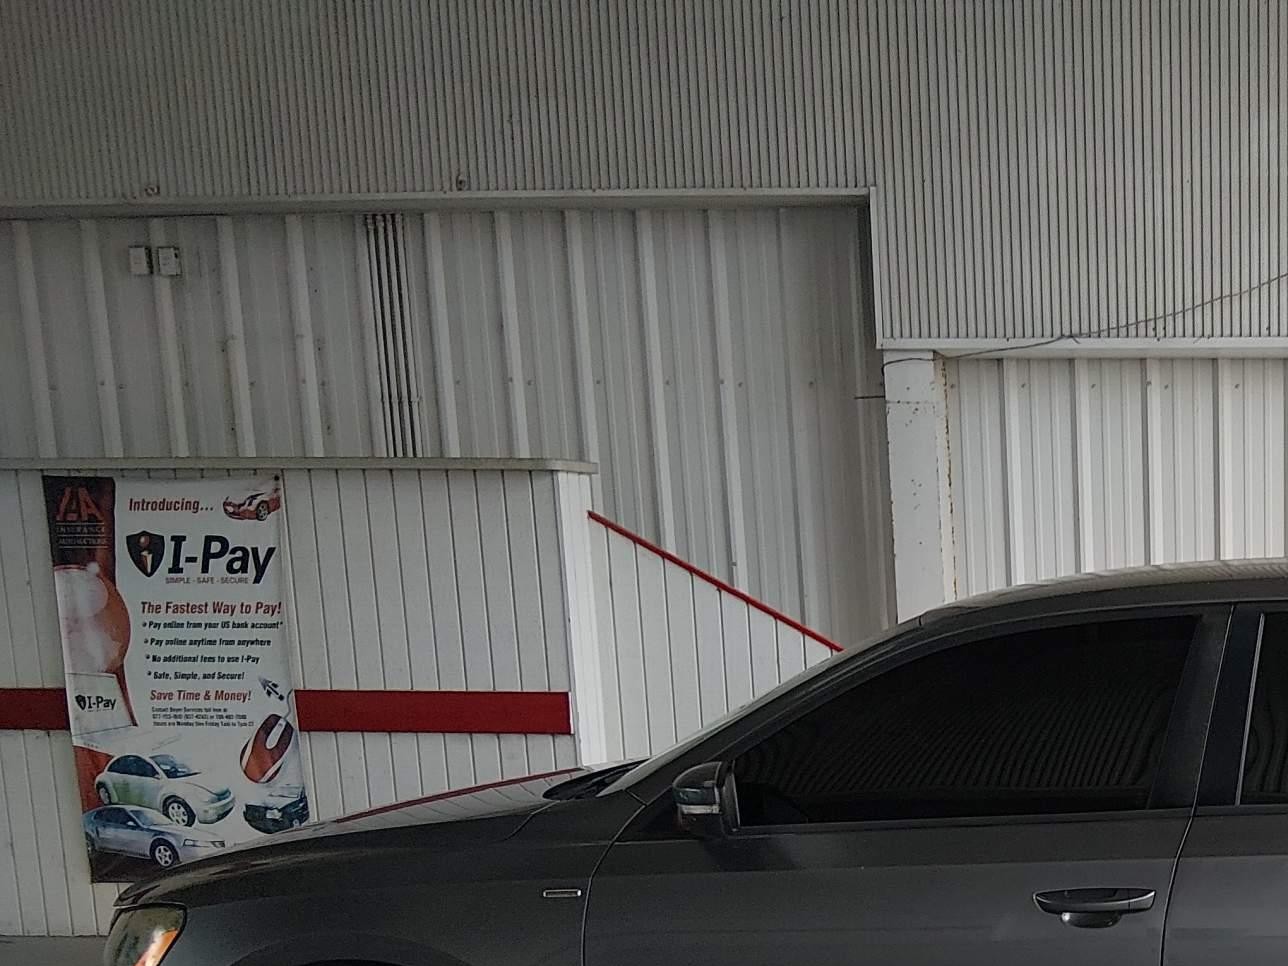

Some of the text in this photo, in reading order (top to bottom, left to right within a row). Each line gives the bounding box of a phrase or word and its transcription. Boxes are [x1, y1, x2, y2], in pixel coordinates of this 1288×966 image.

[129, 498, 214, 513] Introducing...
[167, 535, 276, 584] I-Pay
[165, 577, 191, 585] SIMPLE
[197, 577, 215, 585] SAFE
[220, 577, 249, 585] SECURE
[141, 601, 282, 616] The Fastest Way to Pay!
[148, 621, 161, 630] Pay
[163, 621, 185, 629] online
[187, 621, 202, 629] from
[204, 622, 219, 630] your
[221, 621, 230, 629] US
[232, 621, 248, 629] bank
[150, 638, 271, 647] Pay online anytime from anywhere
[152, 655, 260, 664] No additional fees to use I-Pay
[153, 671, 245, 680] Safe, Simple, and Secure!
[150, 690, 252, 703] Save Time & Money!
[87, 696, 117, 710] I-Pay
